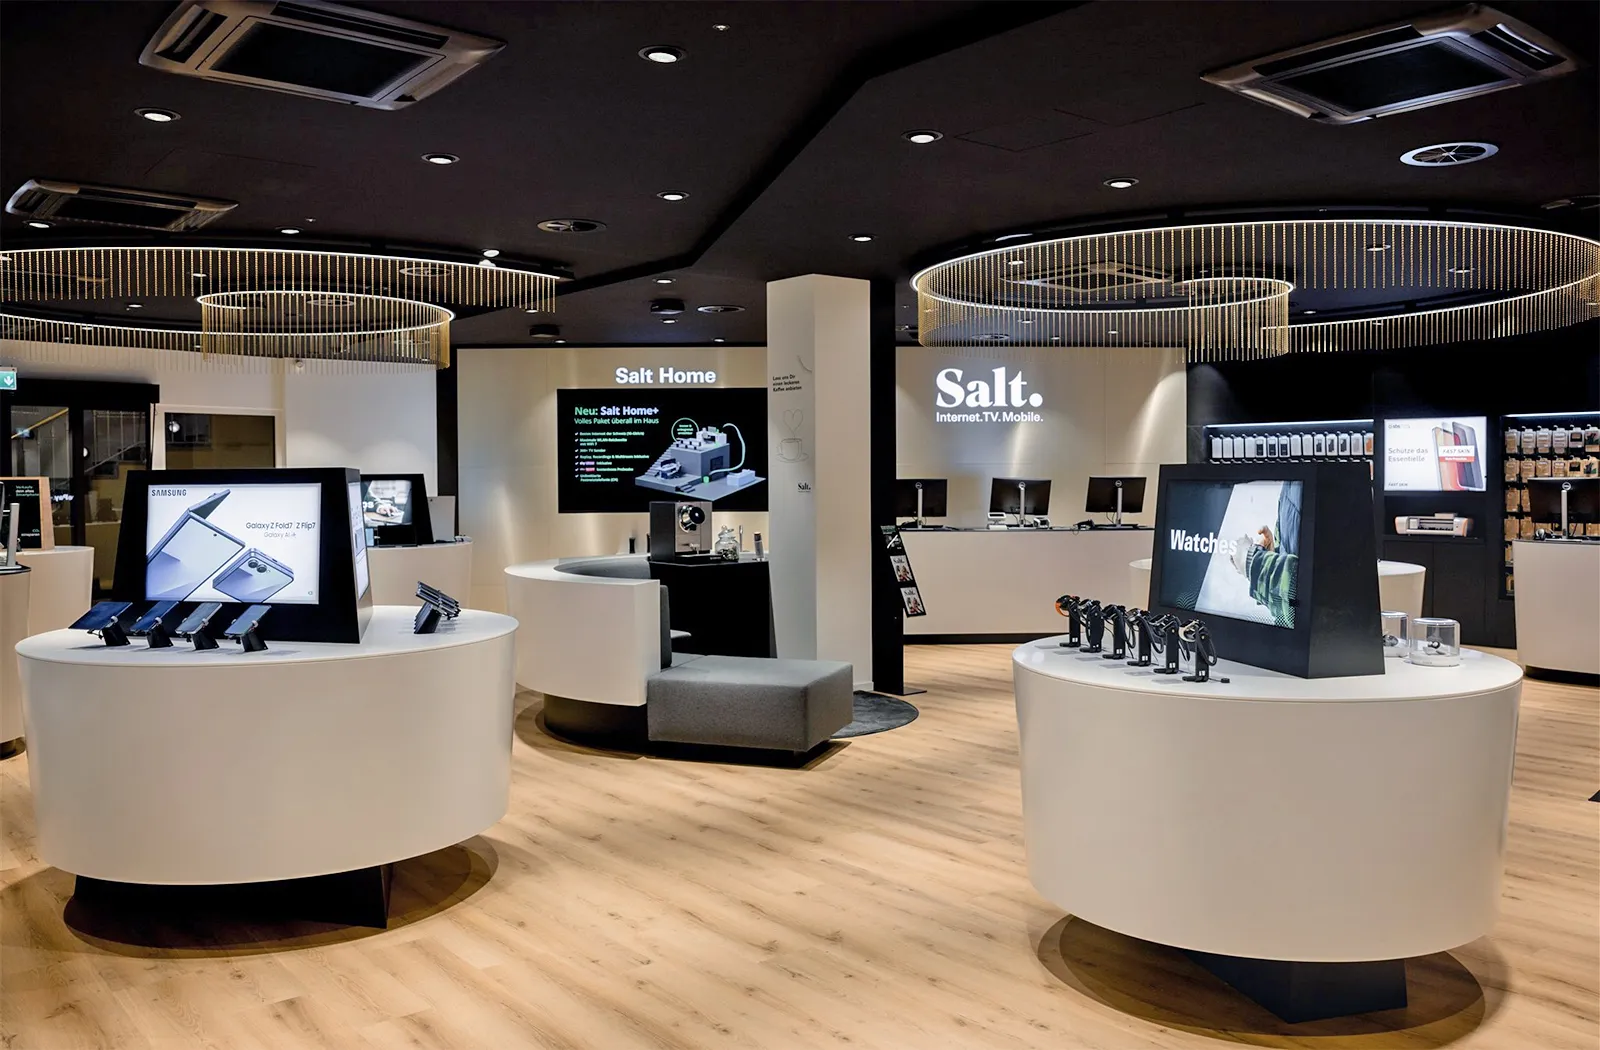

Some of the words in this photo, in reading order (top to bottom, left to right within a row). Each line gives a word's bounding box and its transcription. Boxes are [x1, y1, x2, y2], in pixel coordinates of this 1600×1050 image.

[615, 367, 654, 384] Salt
[659, 367, 716, 384] Home
[936, 366, 1043, 408] Salt.
[574, 406, 599, 416] Neu:
[600, 405, 621, 416] Salt
[622, 405, 660, 416] Home+
[151, 489, 187, 497] SAMSUNG
[246, 522, 270, 530] Galaxy
[301, 522, 316, 530] Flip7
[1170, 529, 1238, 555] Watches
